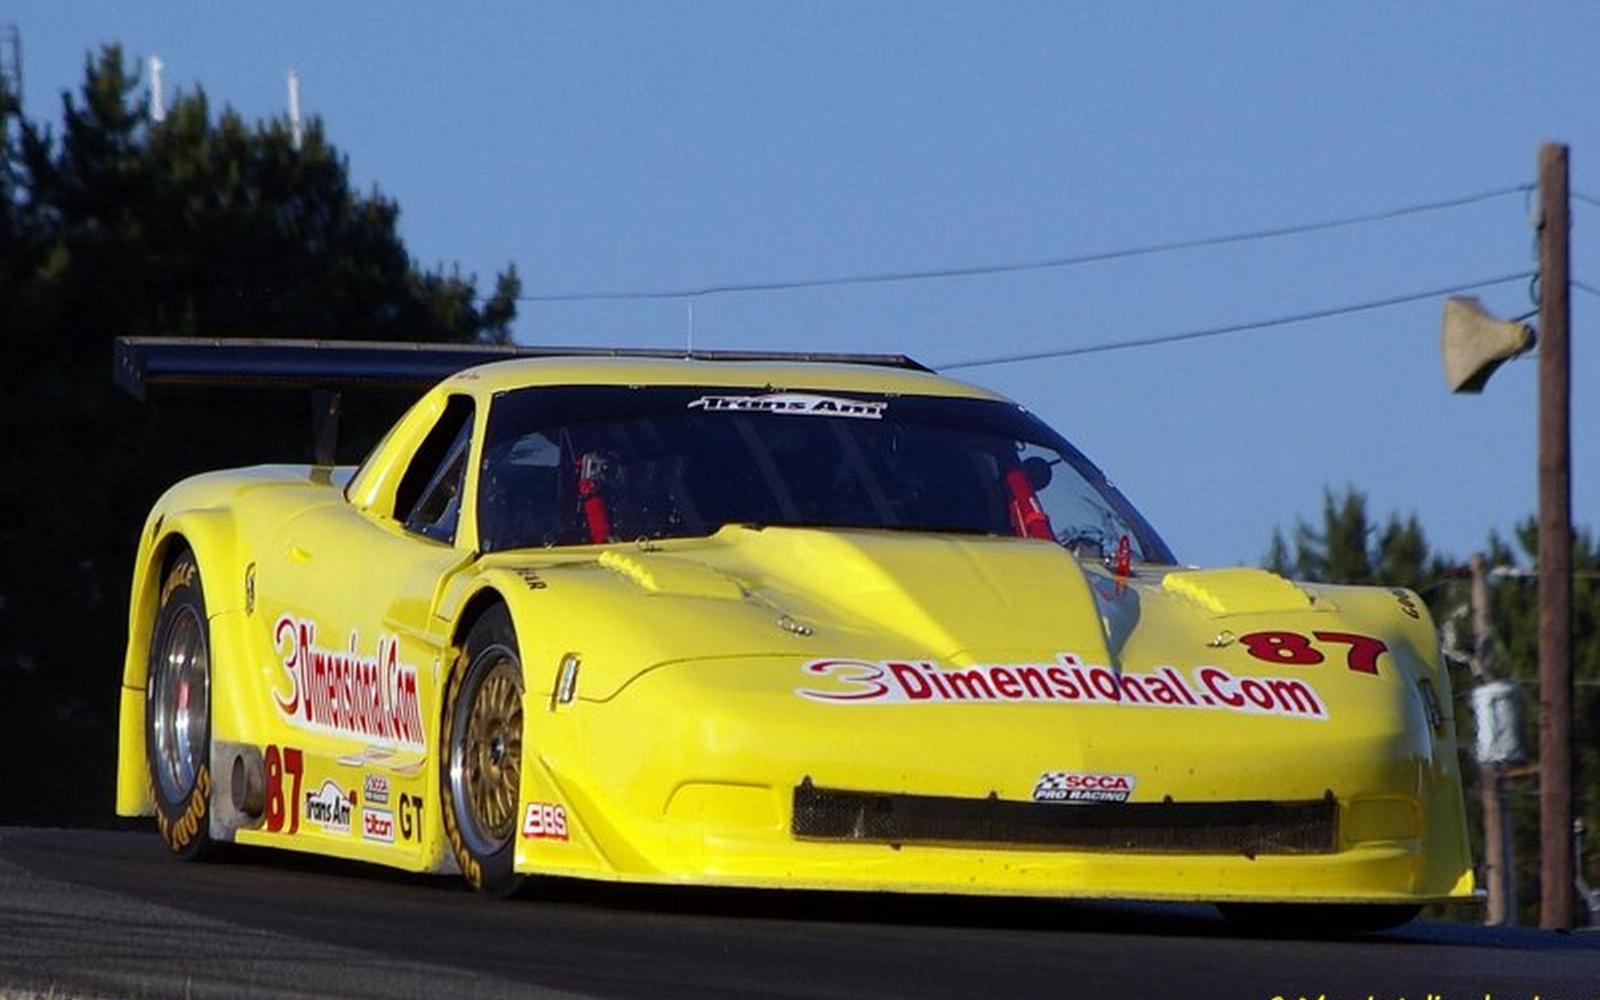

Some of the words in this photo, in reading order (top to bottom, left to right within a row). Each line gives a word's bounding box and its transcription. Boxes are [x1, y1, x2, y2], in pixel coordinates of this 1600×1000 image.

[703, 398, 805, 412] Trans
[812, 399, 883, 417] Am
[1237, 630, 1390, 676] 87
[273, 618, 424, 744] 3Dimensional.Com
[801, 654, 1322, 716] 3Dimensional.Com
[264, 743, 304, 835] 87
[1035, 790, 1066, 800] PRO
[1069, 790, 1126, 802] RACING
[1066, 776, 1129, 789] SCCA
[306, 791, 332, 822] Trans
[333, 795, 351, 825] Am
[399, 792, 424, 844] GT
